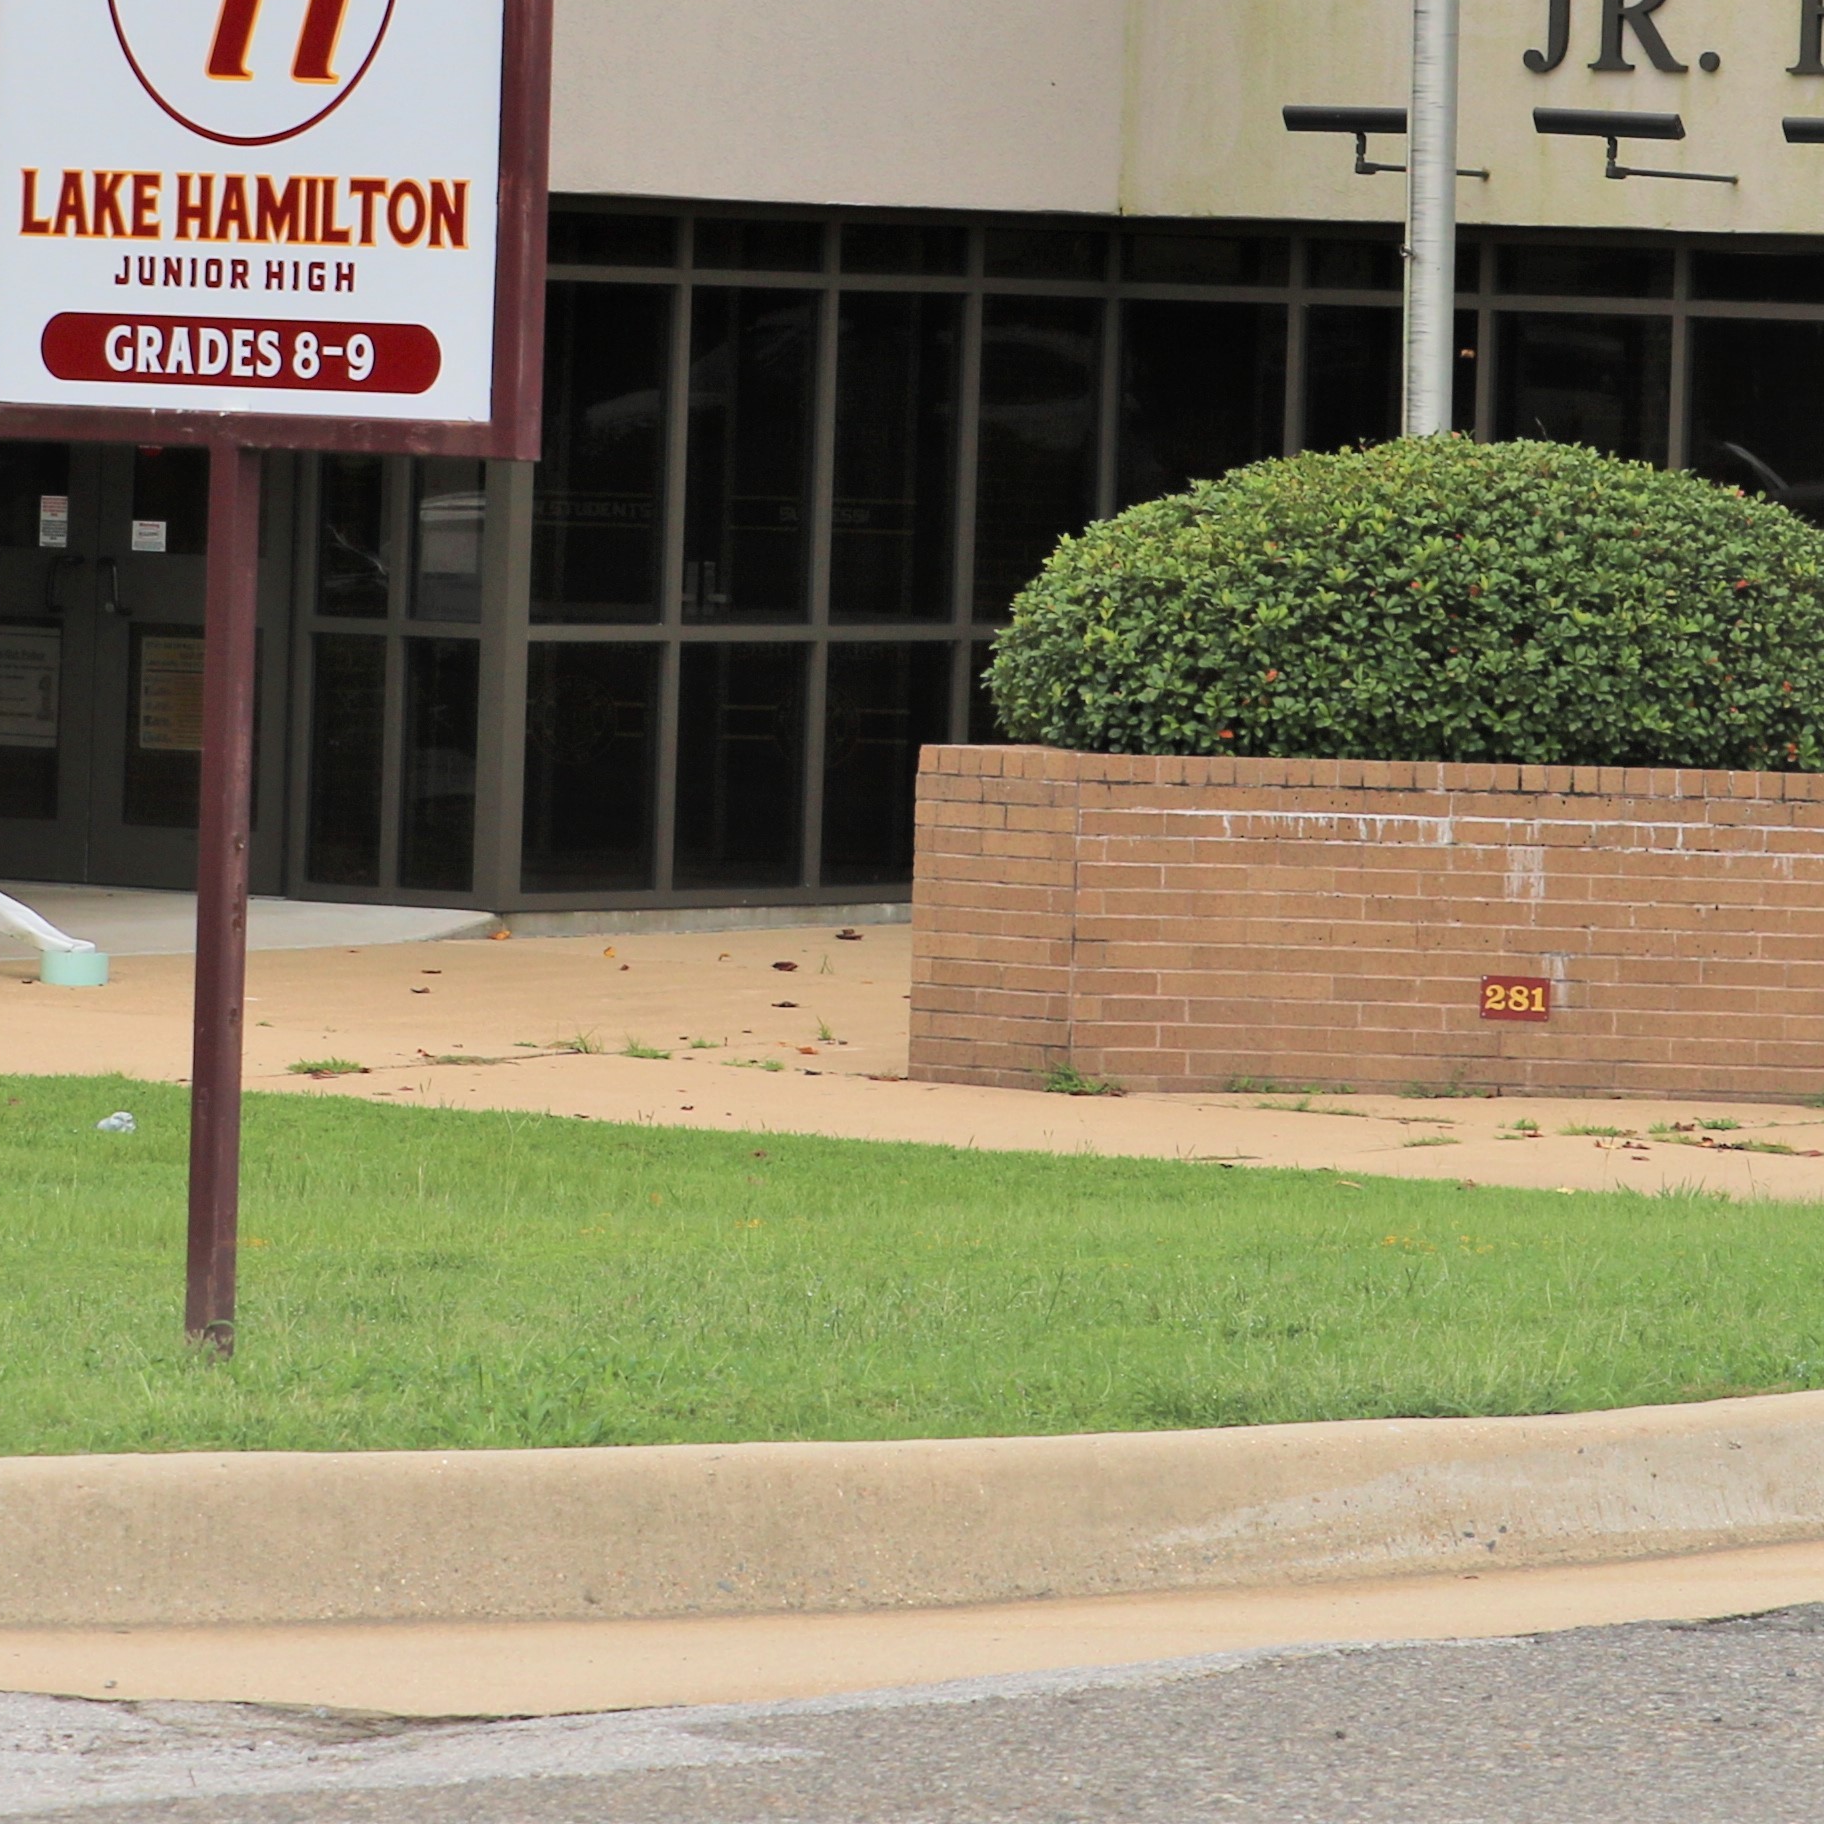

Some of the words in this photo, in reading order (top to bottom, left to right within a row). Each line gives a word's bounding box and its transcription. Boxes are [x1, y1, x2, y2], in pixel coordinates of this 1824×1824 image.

[19, 167, 164, 241] LAKE
[174, 171, 471, 250] HAMILTON
[115, 256, 249, 289] JUNIOR
[265, 260, 356, 293] HIGH
[105, 325, 281, 377] GRADES
[293, 329, 374, 381] 8-9
[1485, 984, 1546, 1011] 281
